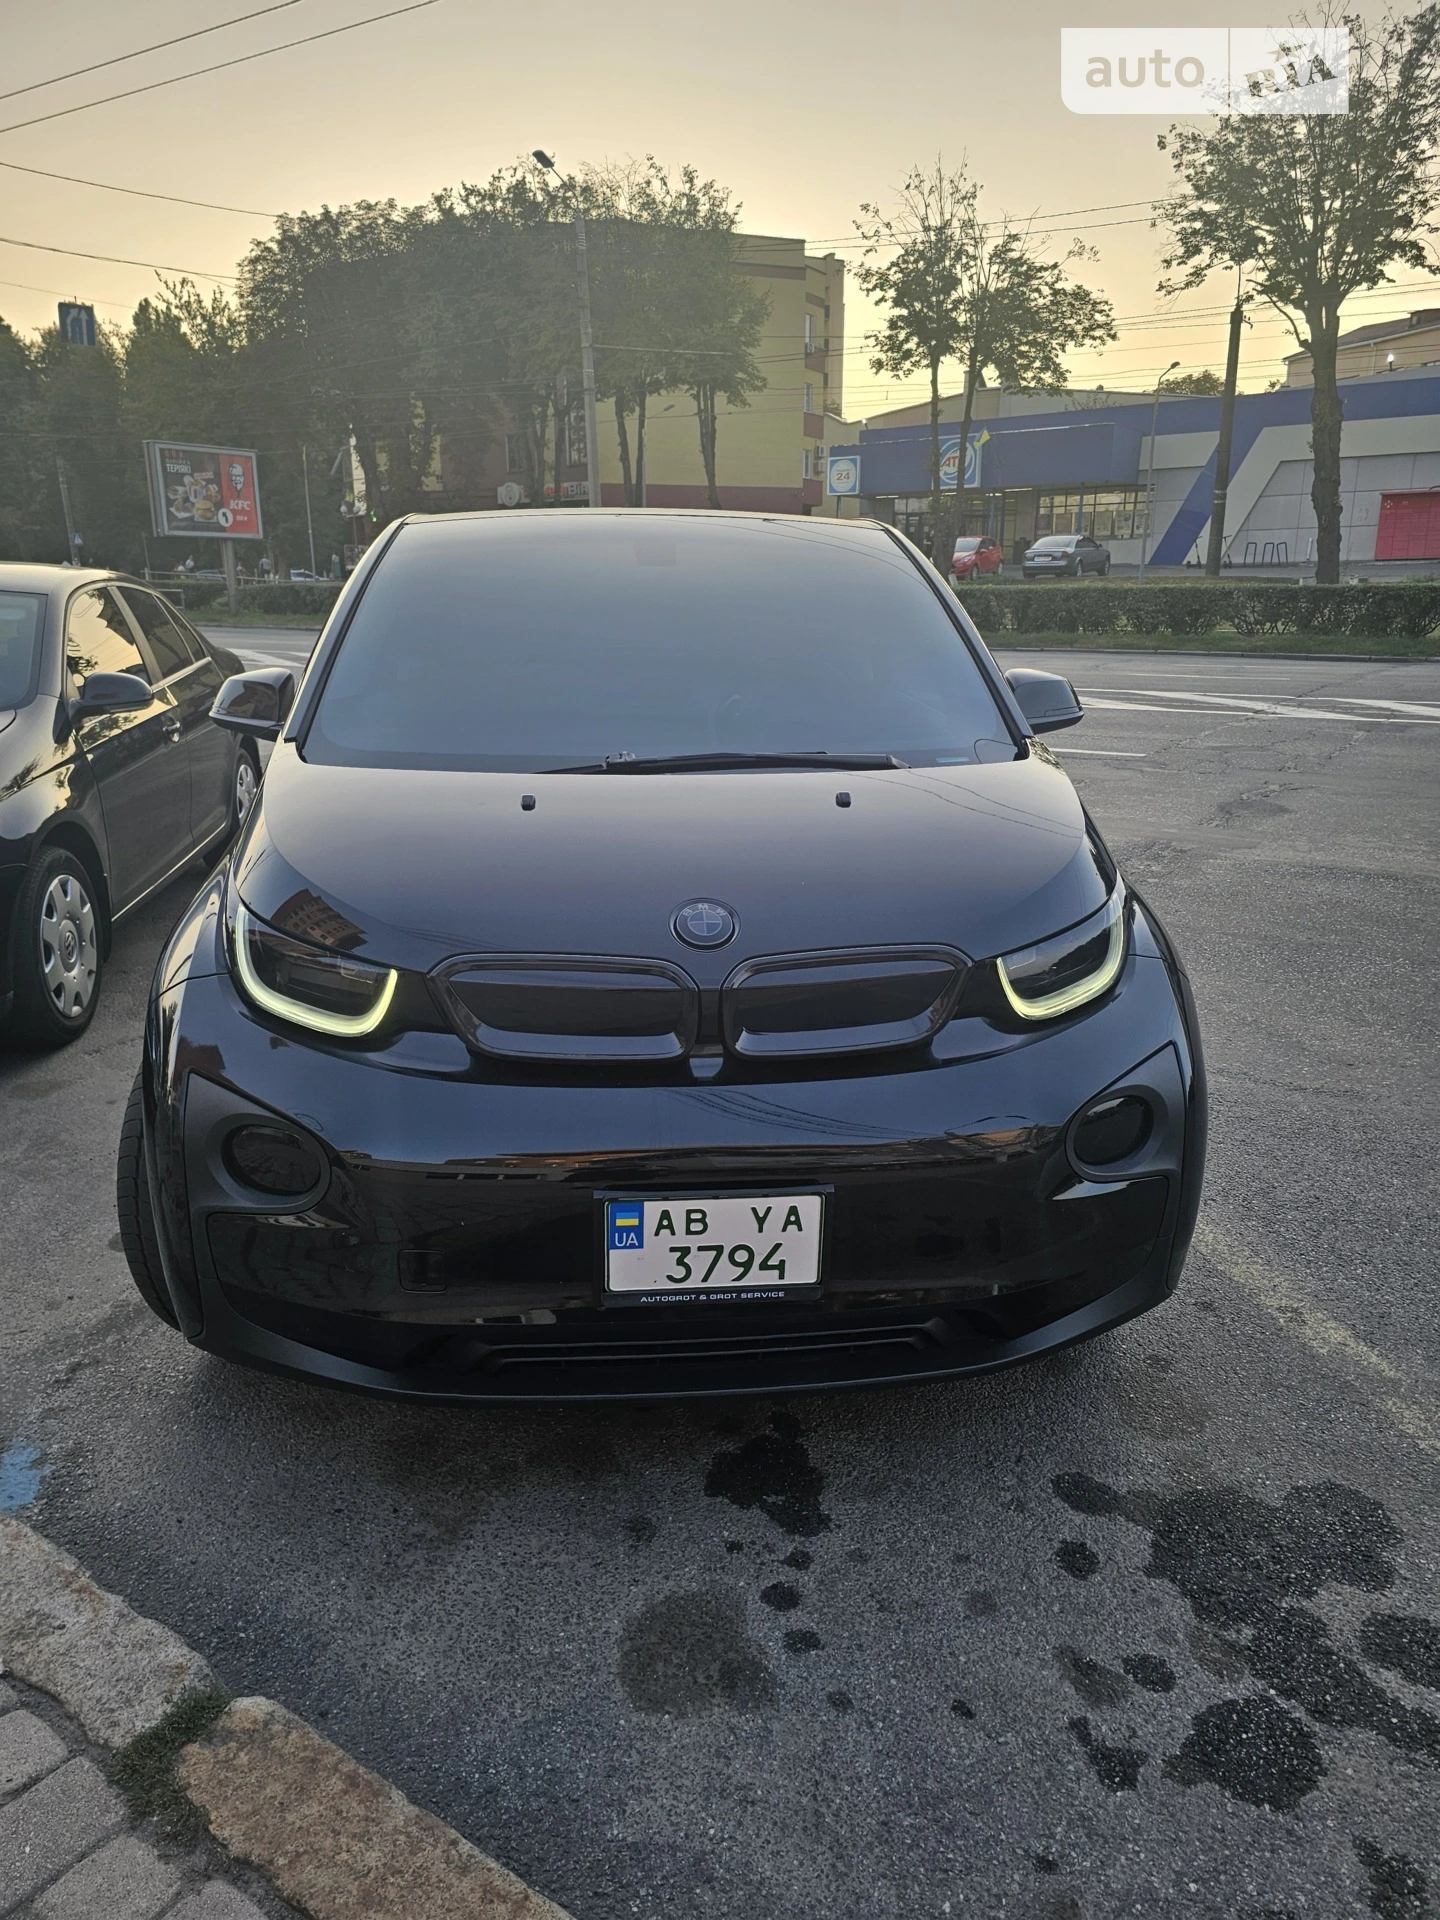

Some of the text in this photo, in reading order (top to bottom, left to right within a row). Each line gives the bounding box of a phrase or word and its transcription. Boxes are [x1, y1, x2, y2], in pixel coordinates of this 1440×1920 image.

[836, 472, 850, 481] 24
[229, 499, 251, 511] KFC
[682, 903, 727, 917] BMW
[614, 1232, 639, 1247] UA
[665, 1242, 786, 1284] 3794
[640, 1294, 697, 1303] AUTOGROT
[709, 1293, 737, 1301] GROT
[740, 1291, 785, 1299] SERVICE
